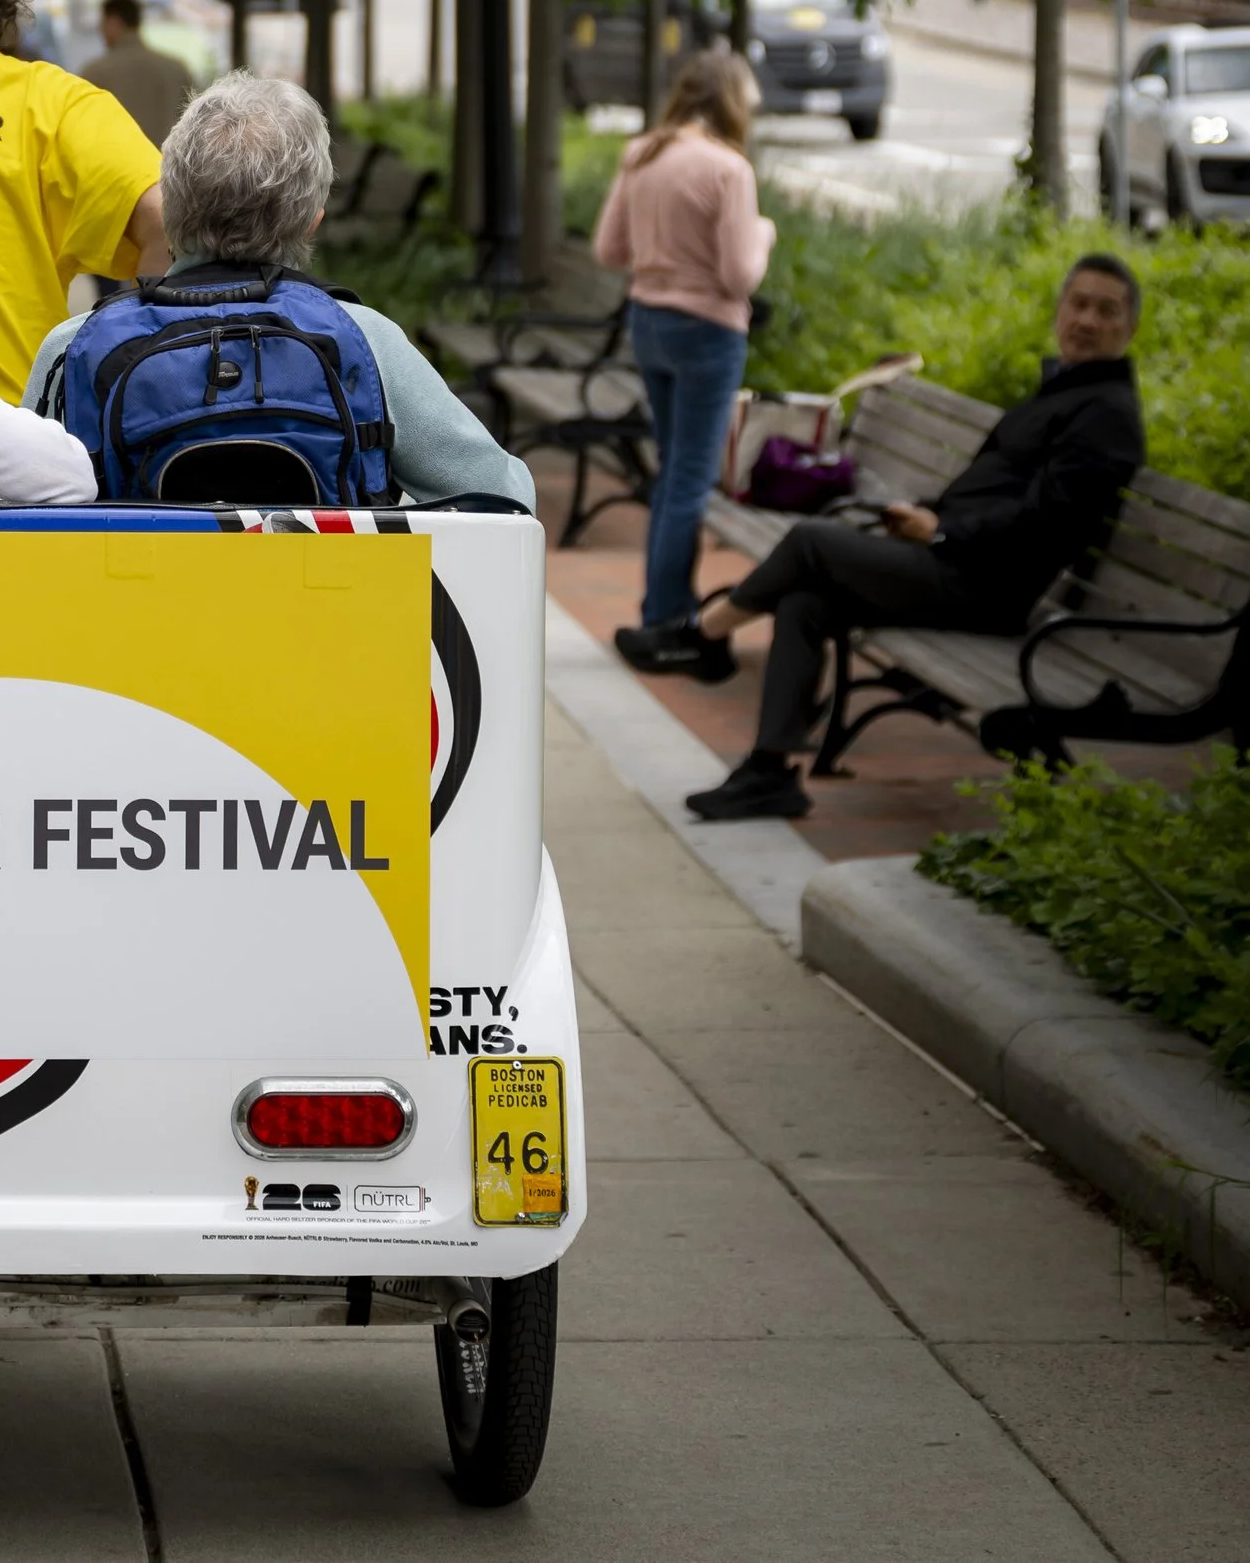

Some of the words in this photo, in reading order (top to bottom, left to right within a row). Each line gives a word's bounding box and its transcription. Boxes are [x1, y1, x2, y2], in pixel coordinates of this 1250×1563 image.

[32, 798, 390, 871] FESTIVAL
[490, 1069, 545, 1082] BOSTON
[493, 1083, 543, 1093] LICENSED
[488, 1094, 548, 1108] PEDICAB
[487, 1131, 549, 1176] 46
[262, 1183, 342, 1212] 26
[528, 1188, 556, 1198] 1/2026
[313, 1201, 332, 1209] FIFA
